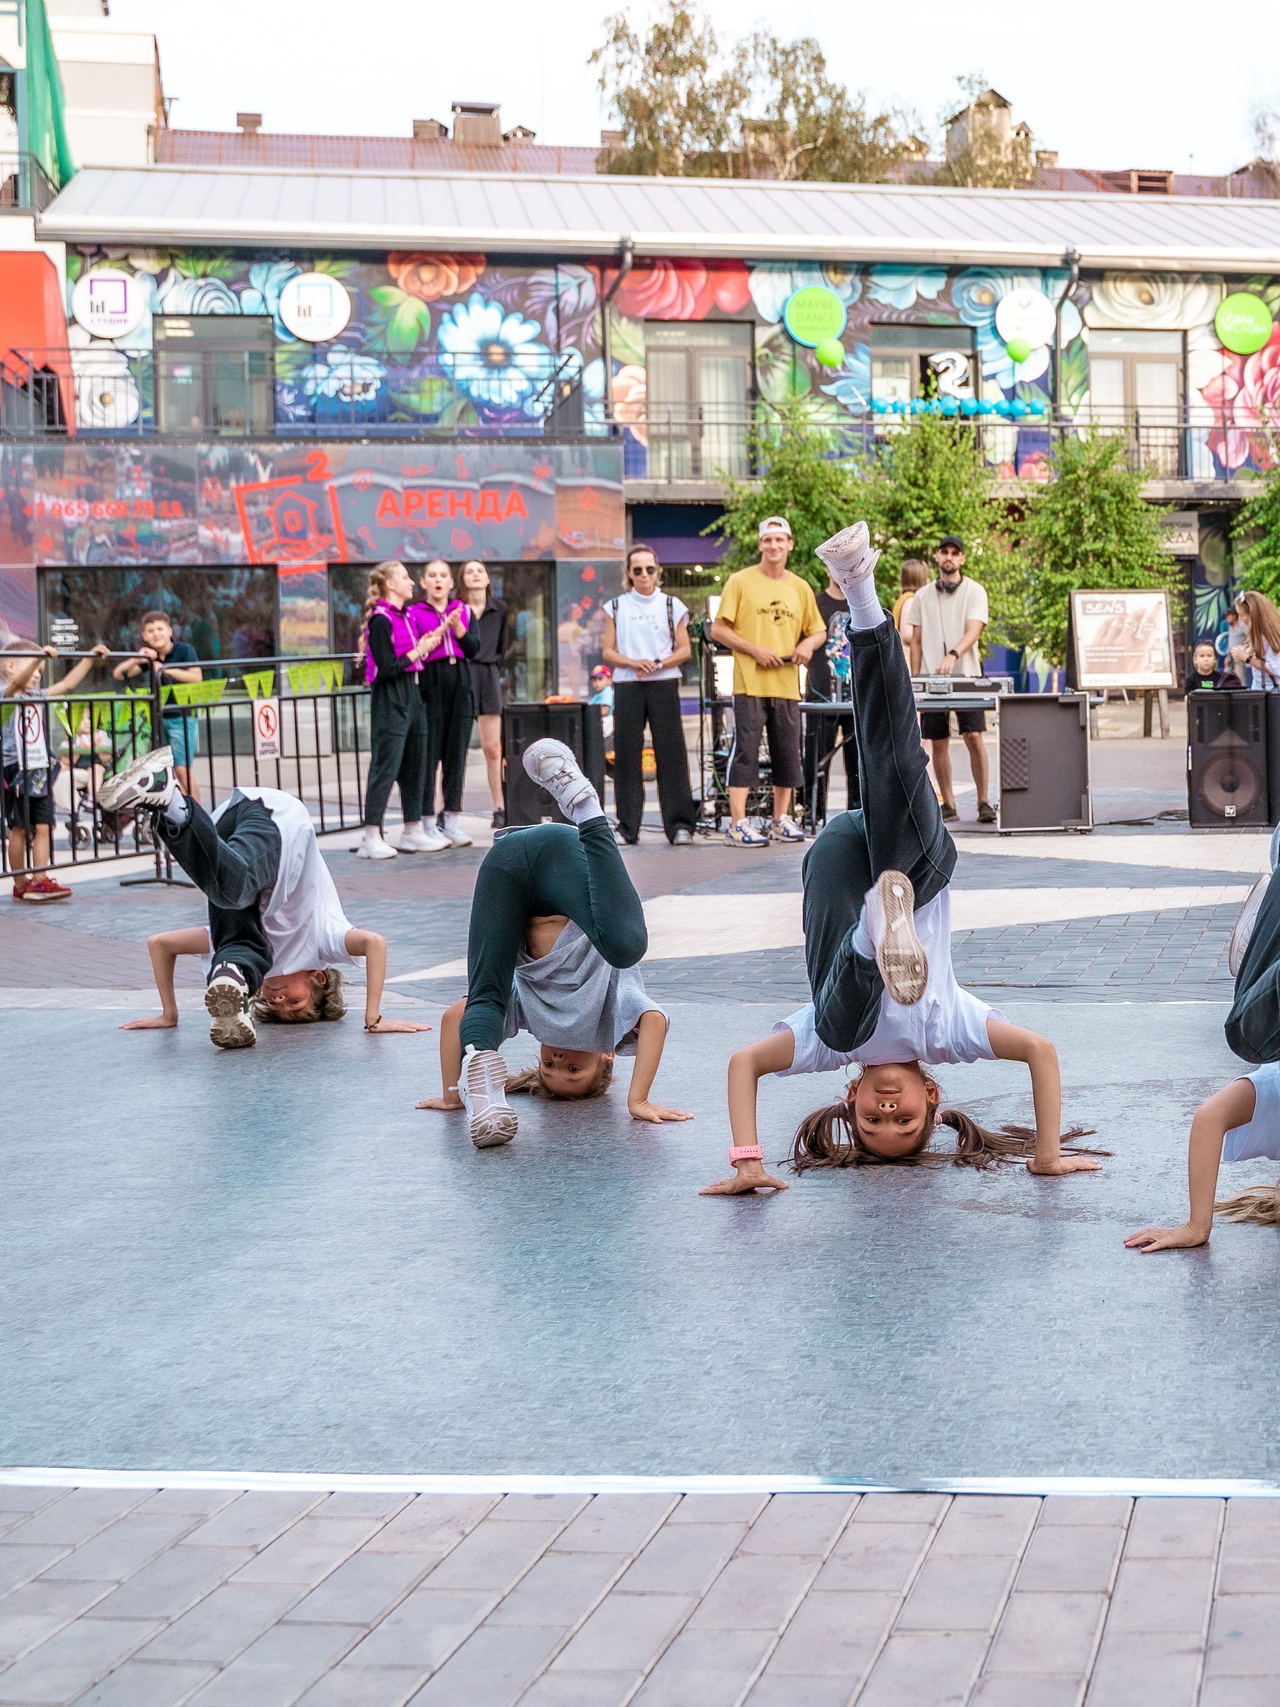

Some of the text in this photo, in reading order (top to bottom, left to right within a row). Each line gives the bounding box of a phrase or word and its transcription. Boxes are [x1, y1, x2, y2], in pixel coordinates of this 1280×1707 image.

[927, 350, 974, 399] 2
[305, 450, 333, 482] 2
[376, 488, 528, 523] АРЕНДА
[1085, 600, 1125, 614] SENS
